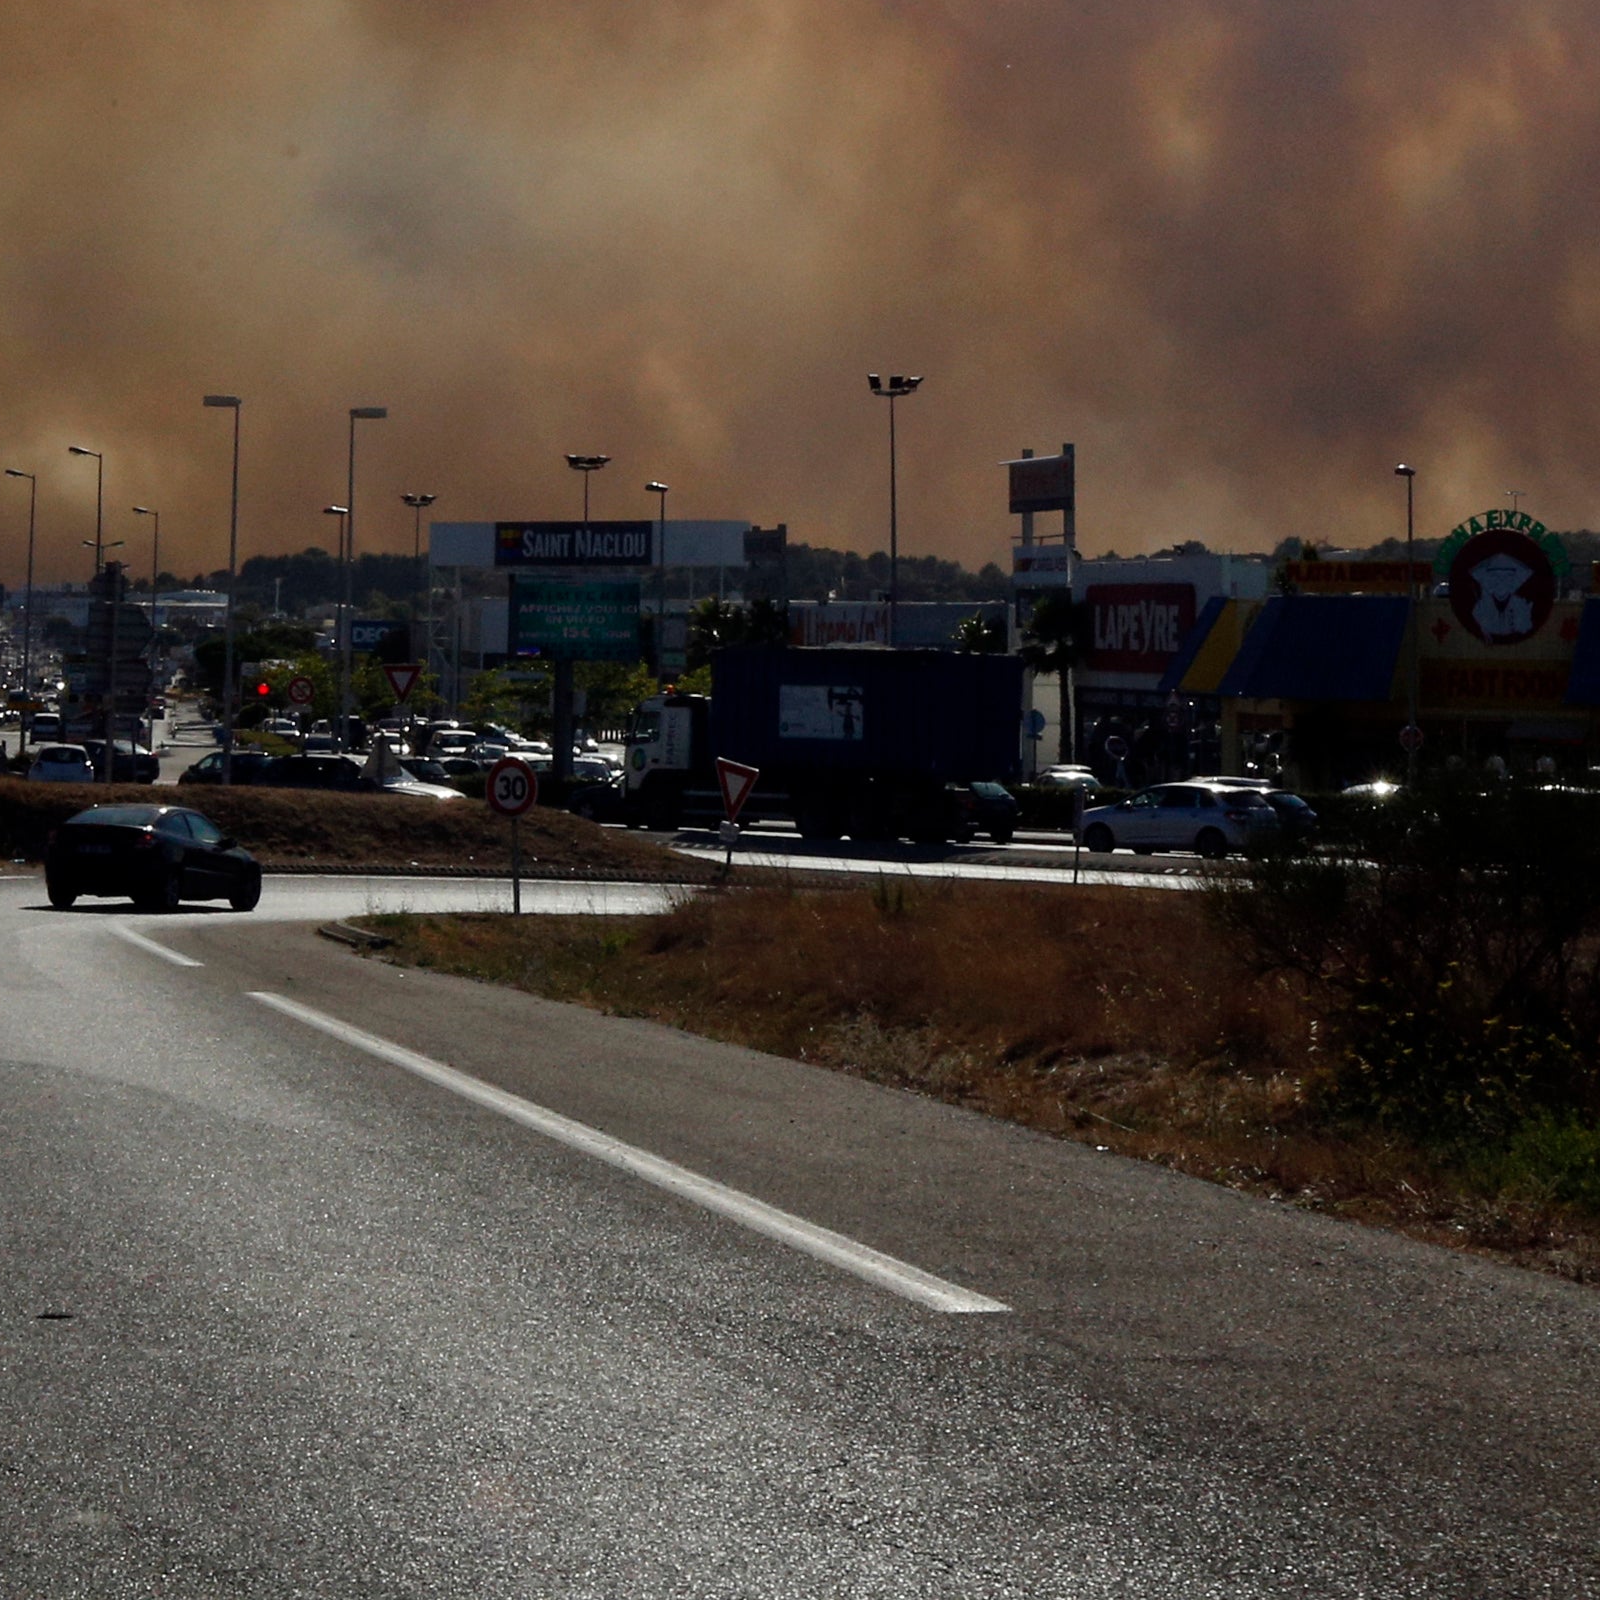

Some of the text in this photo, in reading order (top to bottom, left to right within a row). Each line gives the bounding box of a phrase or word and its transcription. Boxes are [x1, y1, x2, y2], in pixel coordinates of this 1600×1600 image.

[522, 529, 646, 558] SAINT MACLOU
[1094, 600, 1179, 654] LAPEYRE
[1447, 669, 1558, 699] FAST FOOD
[499, 776, 526, 800] 30
